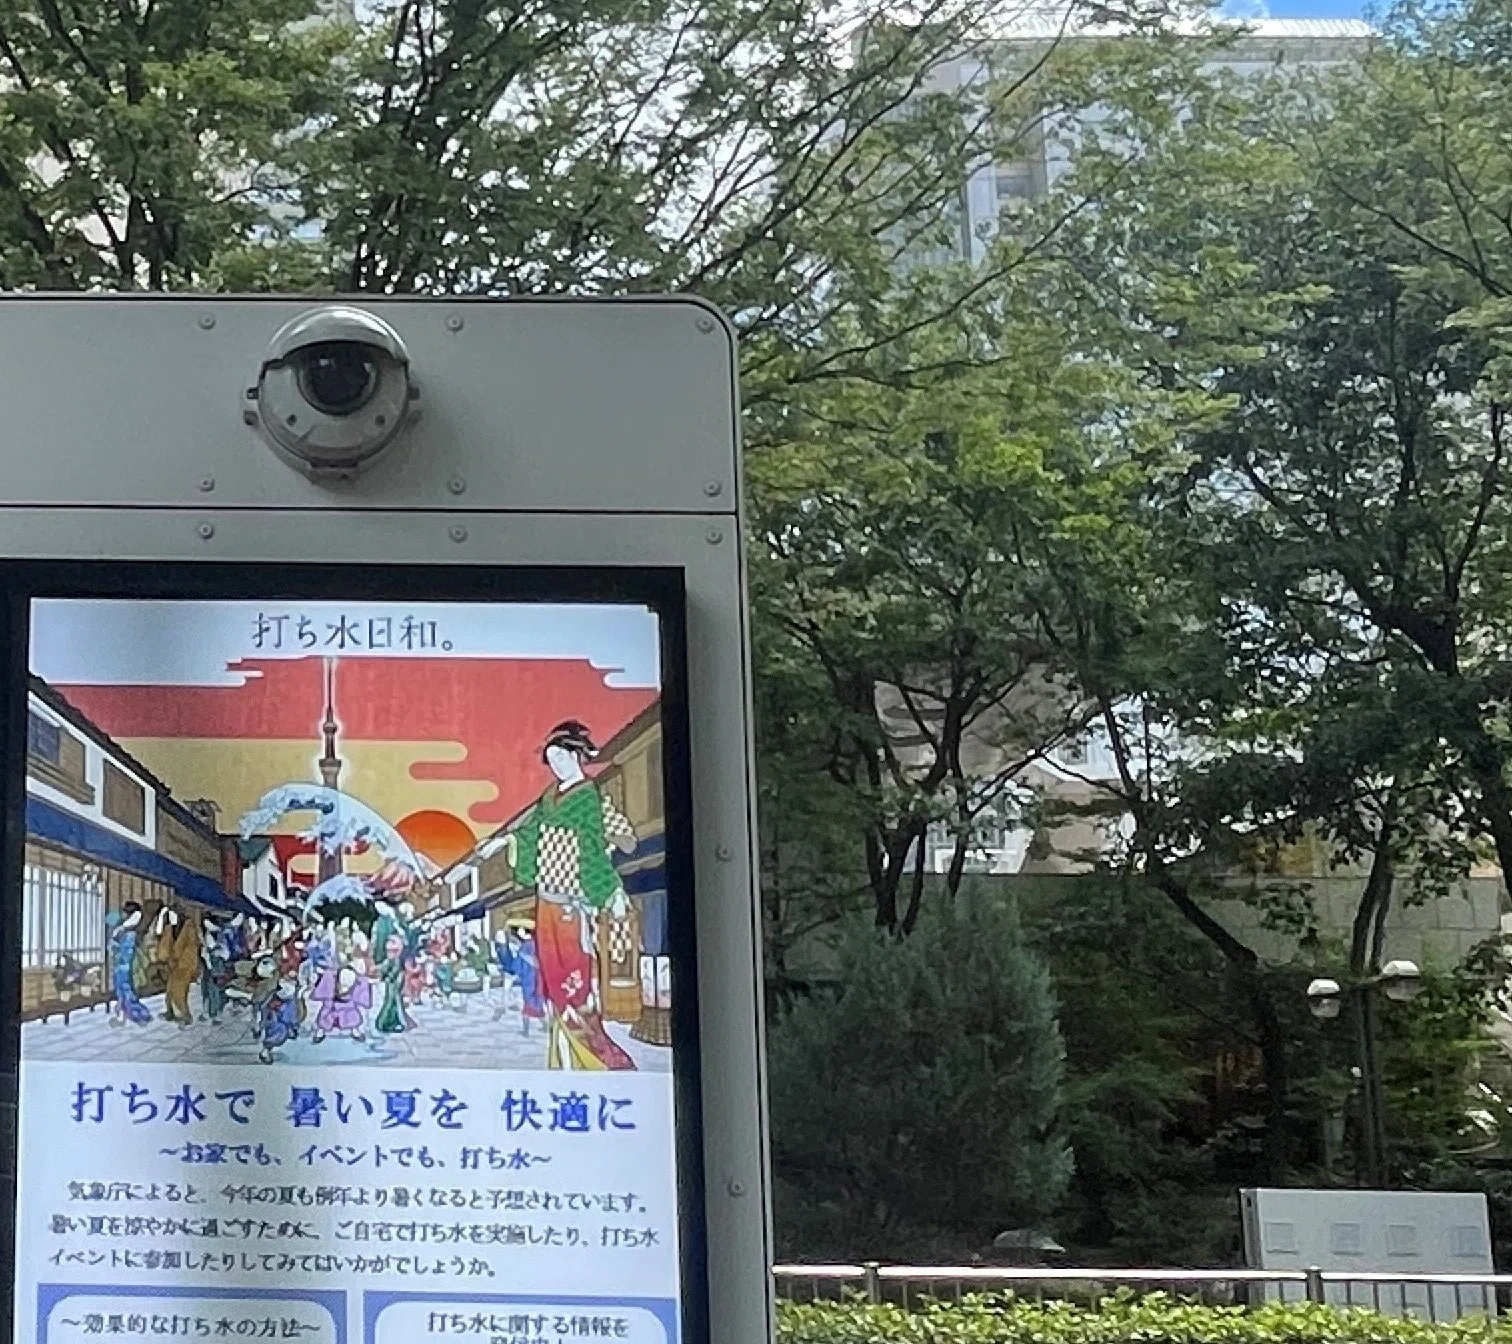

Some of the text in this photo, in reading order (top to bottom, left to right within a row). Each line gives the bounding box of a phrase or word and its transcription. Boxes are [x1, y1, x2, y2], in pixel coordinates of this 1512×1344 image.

[251, 612, 456, 652] 打ち水日和。
[70, 1081, 637, 1132] 打ち水で 暑い夏を 快適に
[428, 1311, 629, 1338] 打ち水に関する情報を
